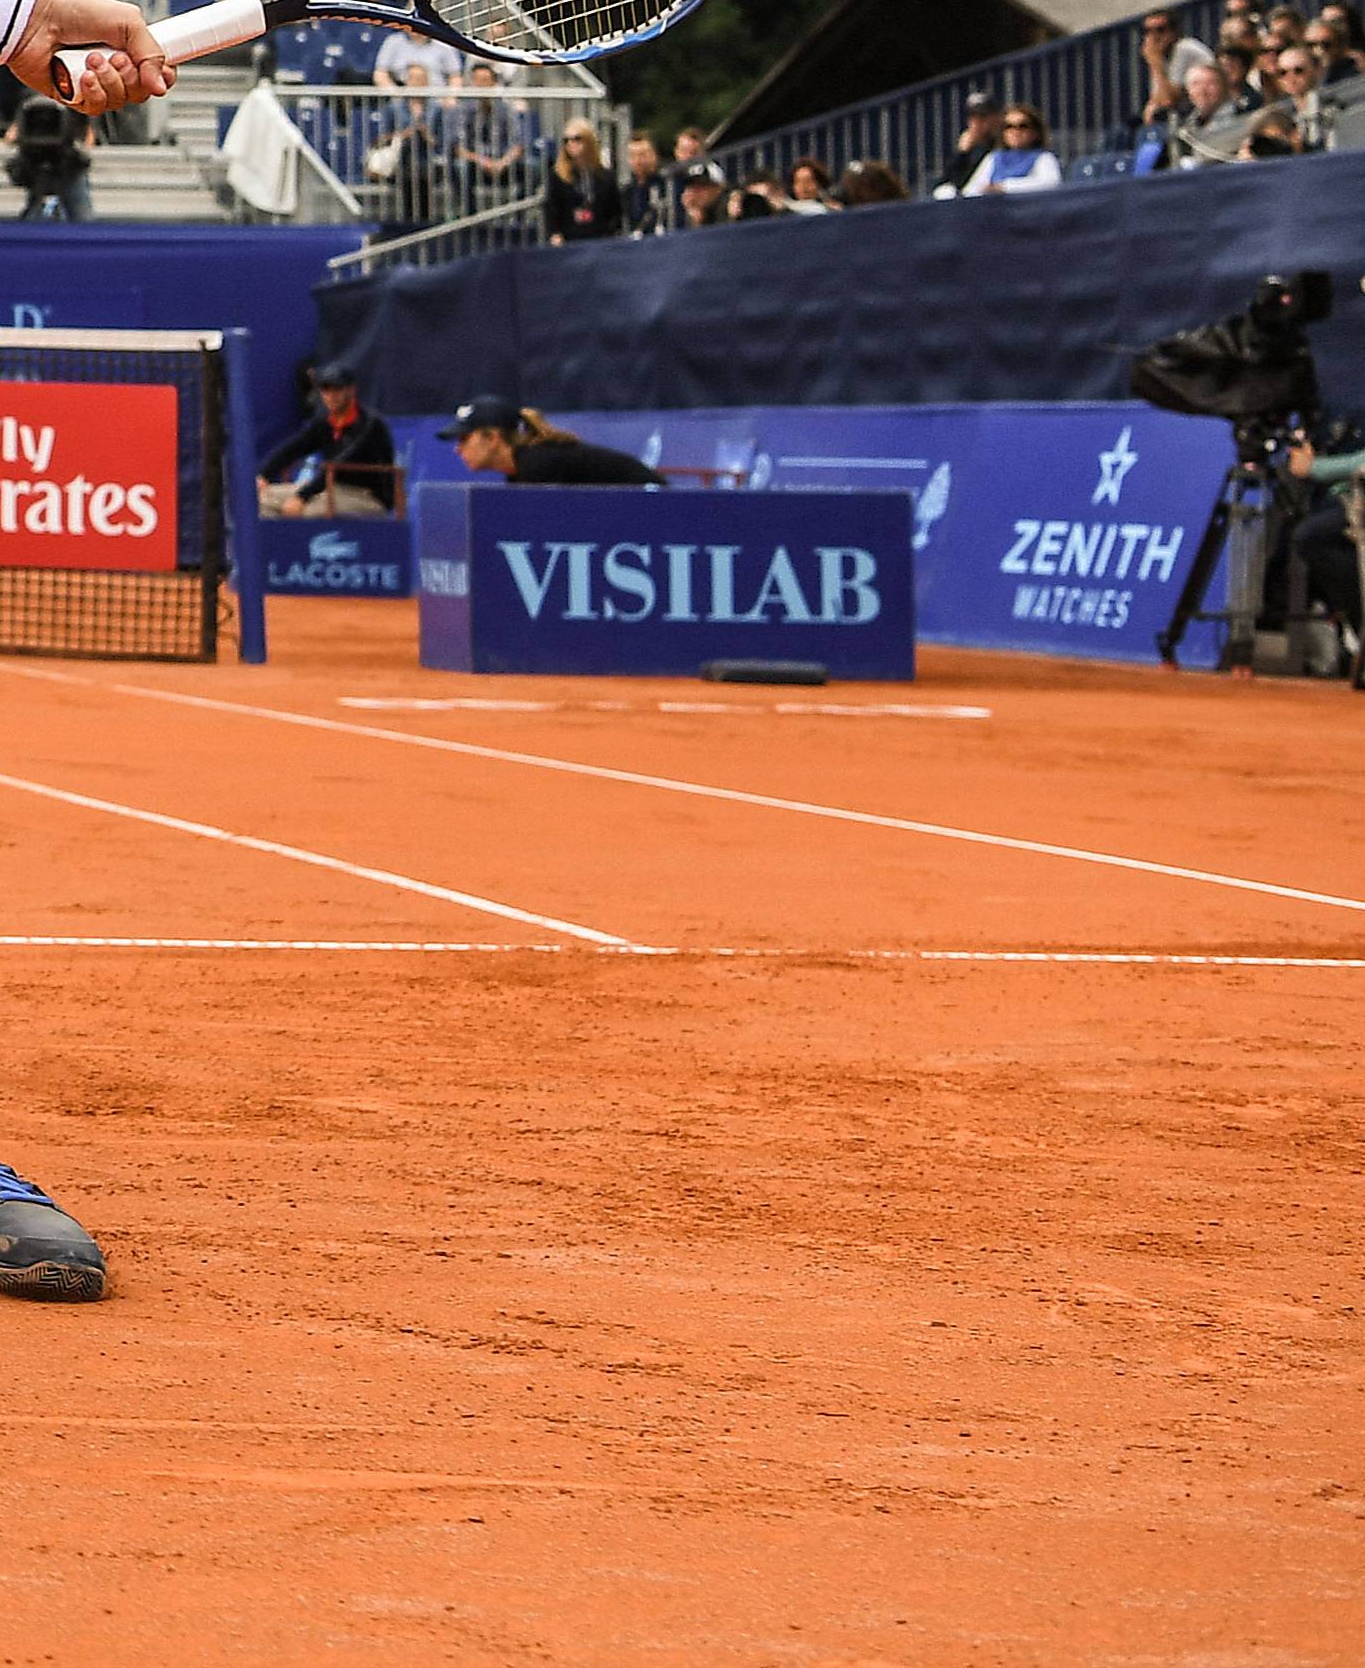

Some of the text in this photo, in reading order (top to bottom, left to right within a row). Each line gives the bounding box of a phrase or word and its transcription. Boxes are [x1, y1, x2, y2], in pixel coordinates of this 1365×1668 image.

[267, 561, 400, 590] LACOSTE
[999, 517, 1184, 583] ZENITH
[495, 539, 882, 626] VISILAB
[1011, 585, 1134, 629] WATCHES
